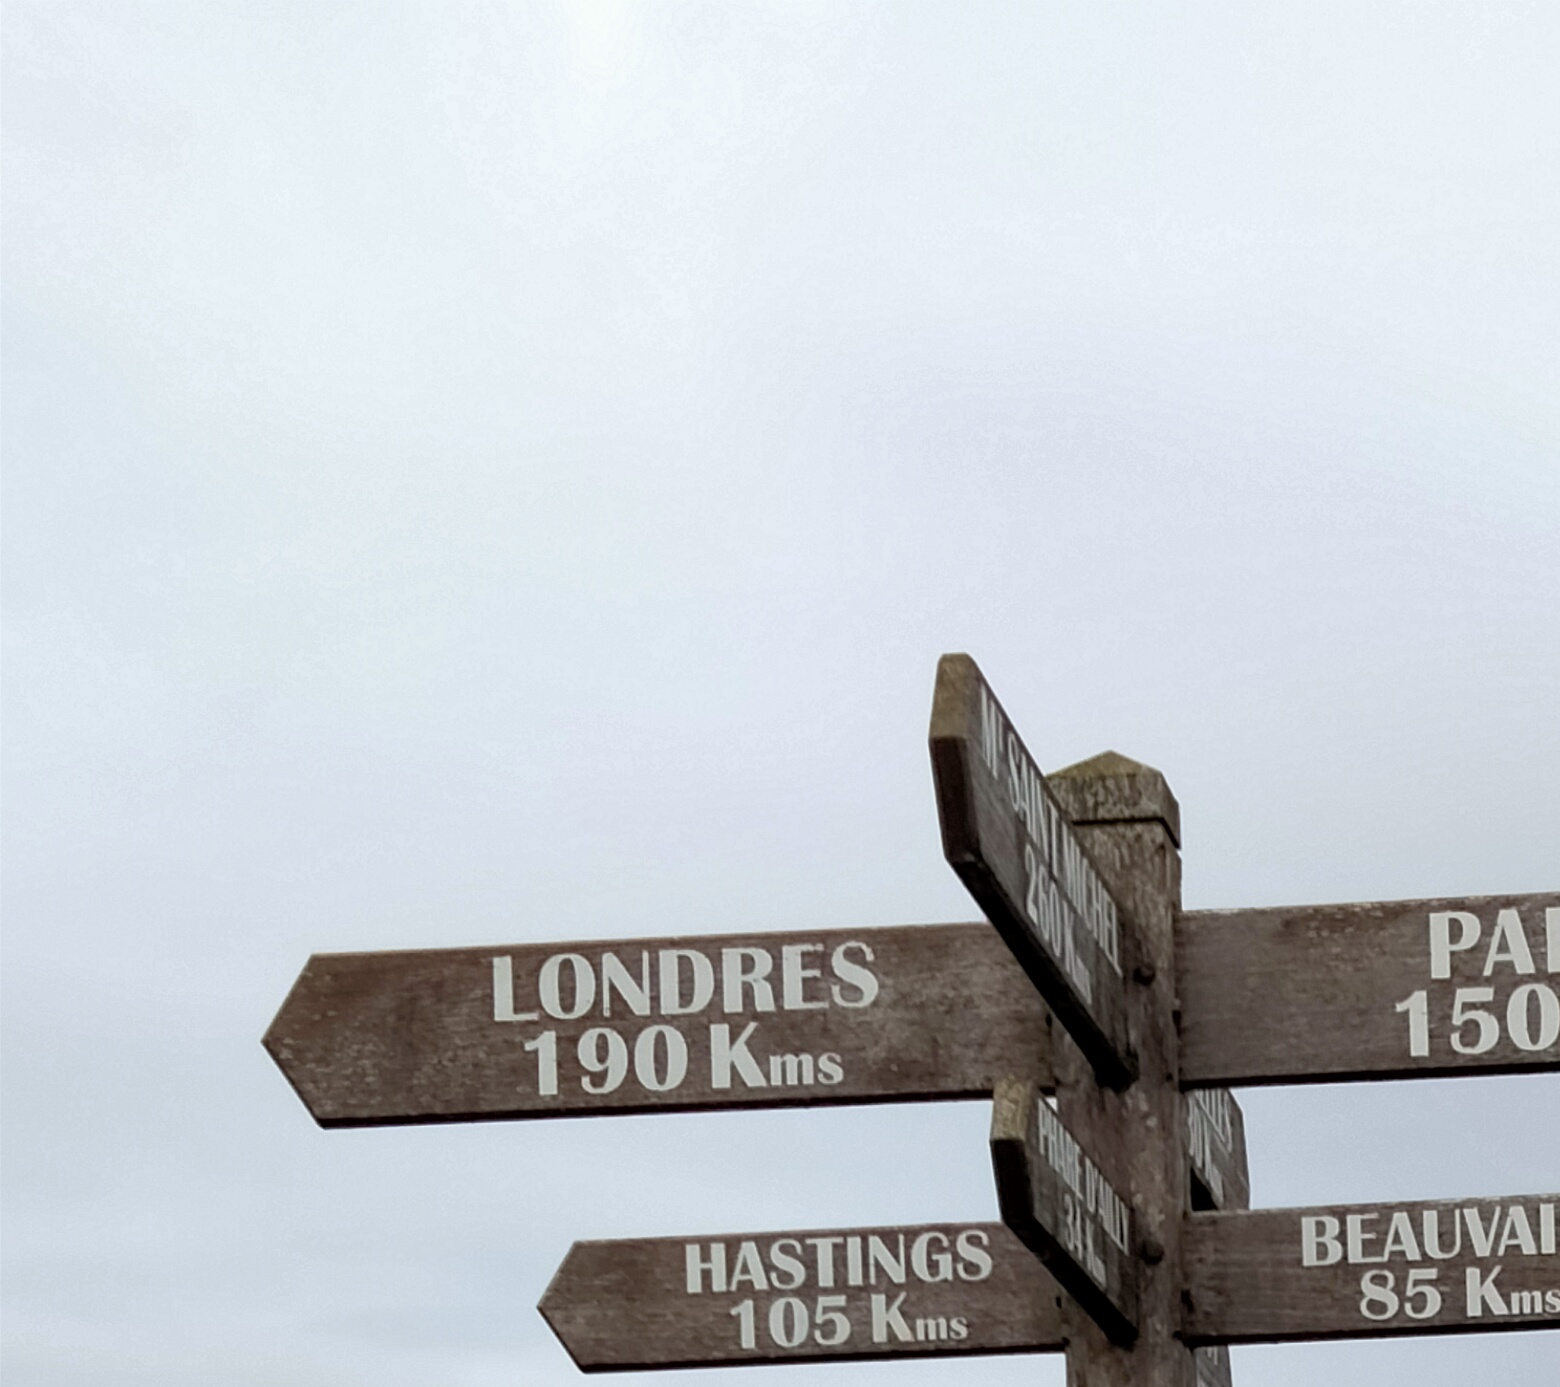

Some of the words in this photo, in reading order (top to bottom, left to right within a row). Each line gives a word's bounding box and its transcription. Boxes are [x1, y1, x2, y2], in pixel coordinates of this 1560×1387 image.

[1008, 729, 1059, 878] SAINT
[1061, 820, 1123, 979] MICHEL
[1025, 842, 1061, 958] 260
[492, 941, 880, 1022] LONDRES
[524, 1024, 689, 1096] 190
[709, 1021, 844, 1089] Kms
[1038, 1098, 1083, 1200] PHARE
[685, 1229, 993, 1294] HASTINGS
[1063, 1193, 1083, 1261] 34
[729, 1295, 852, 1350] 105
[870, 1291, 969, 1343] Kms
[1359, 1268, 1443, 1321] 85
